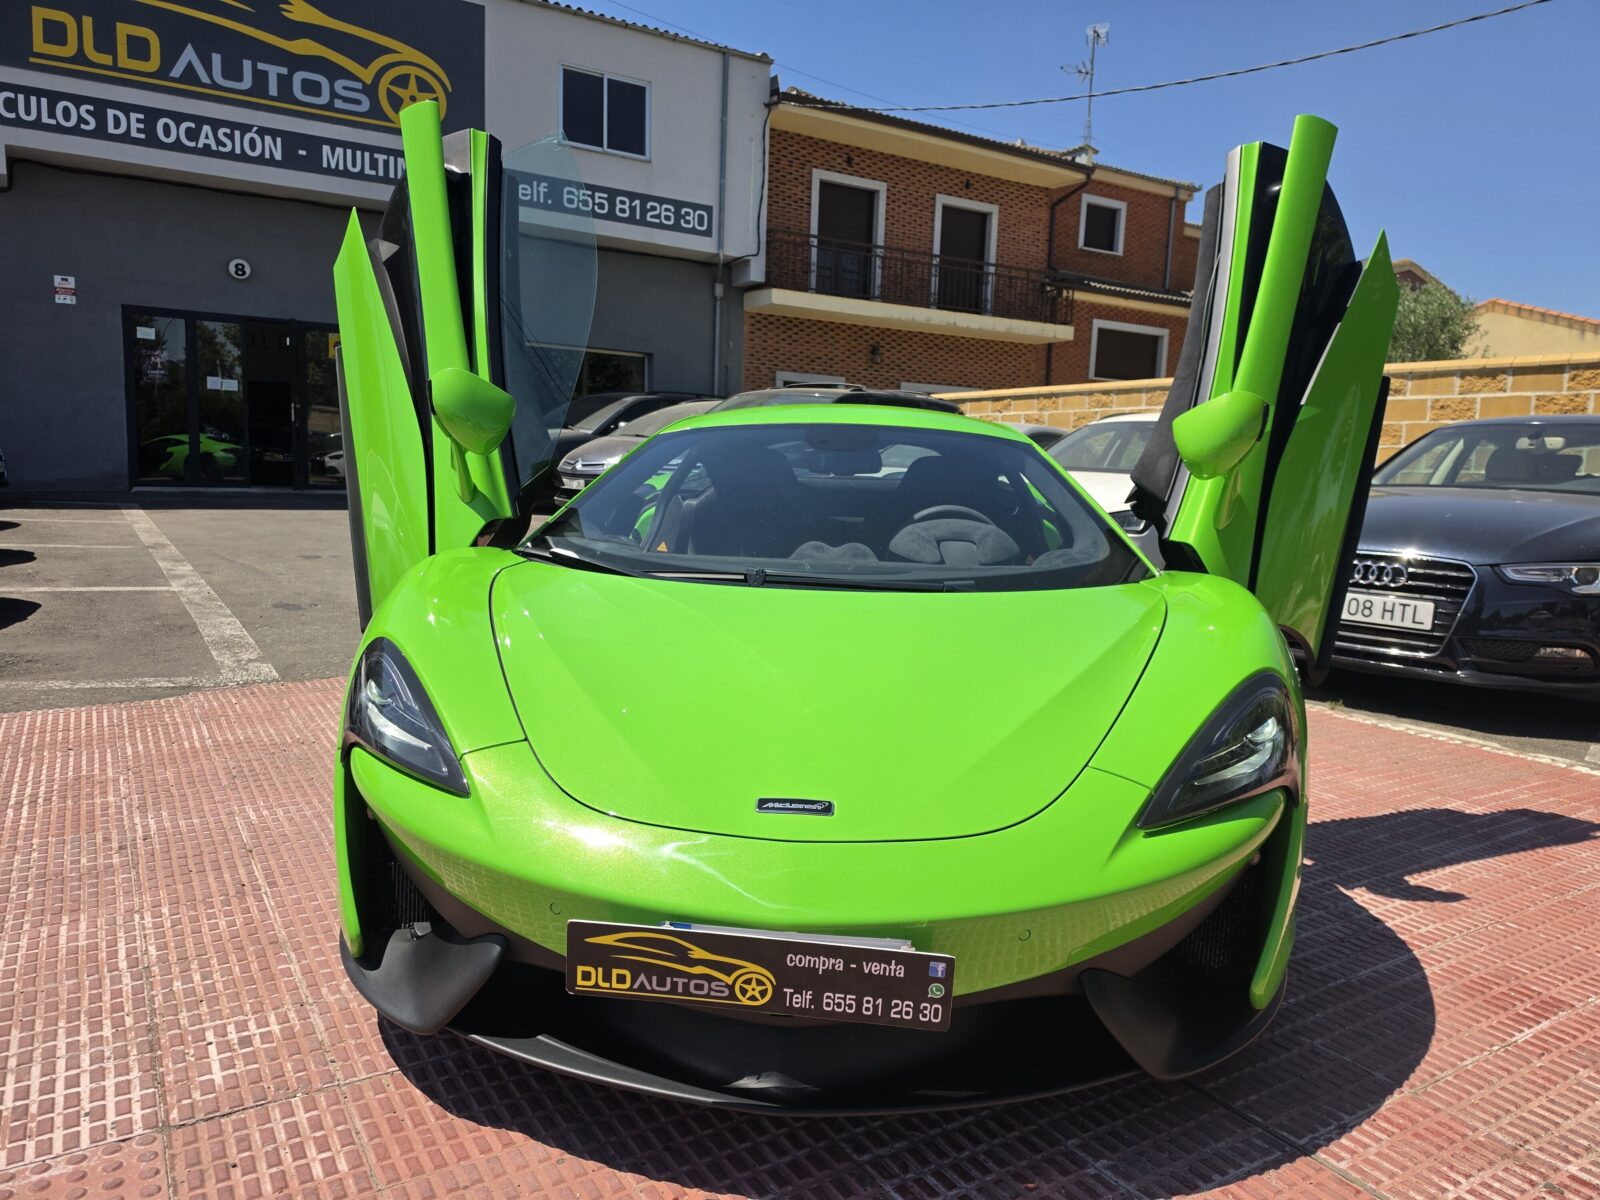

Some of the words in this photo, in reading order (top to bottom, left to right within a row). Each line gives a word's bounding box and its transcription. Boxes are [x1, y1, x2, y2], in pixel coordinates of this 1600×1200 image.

[31, 6, 161, 73] DLD
[168, 43, 371, 113] AUTOS
[0, 91, 96, 131] CULOS
[107, 109, 146, 139] DE
[156, 126, 282, 161] OCASIÓN
[563, 187, 608, 214] 655
[680, 208, 708, 231] 30
[234, 262, 246, 277] 8
[1347, 597, 1374, 617] 08
[1381, 601, 1424, 625] HTL
[576, 966, 631, 989] DLD
[632, 972, 729, 997] AUTOS
[786, 953, 844, 975] compra
[862, 960, 904, 977] venta
[784, 988, 815, 1010] Telf.
[822, 992, 856, 1014] 655
[862, 997, 883, 1016] 81
[890, 1001, 913, 1019] 26
[919, 1003, 942, 1023] 30
